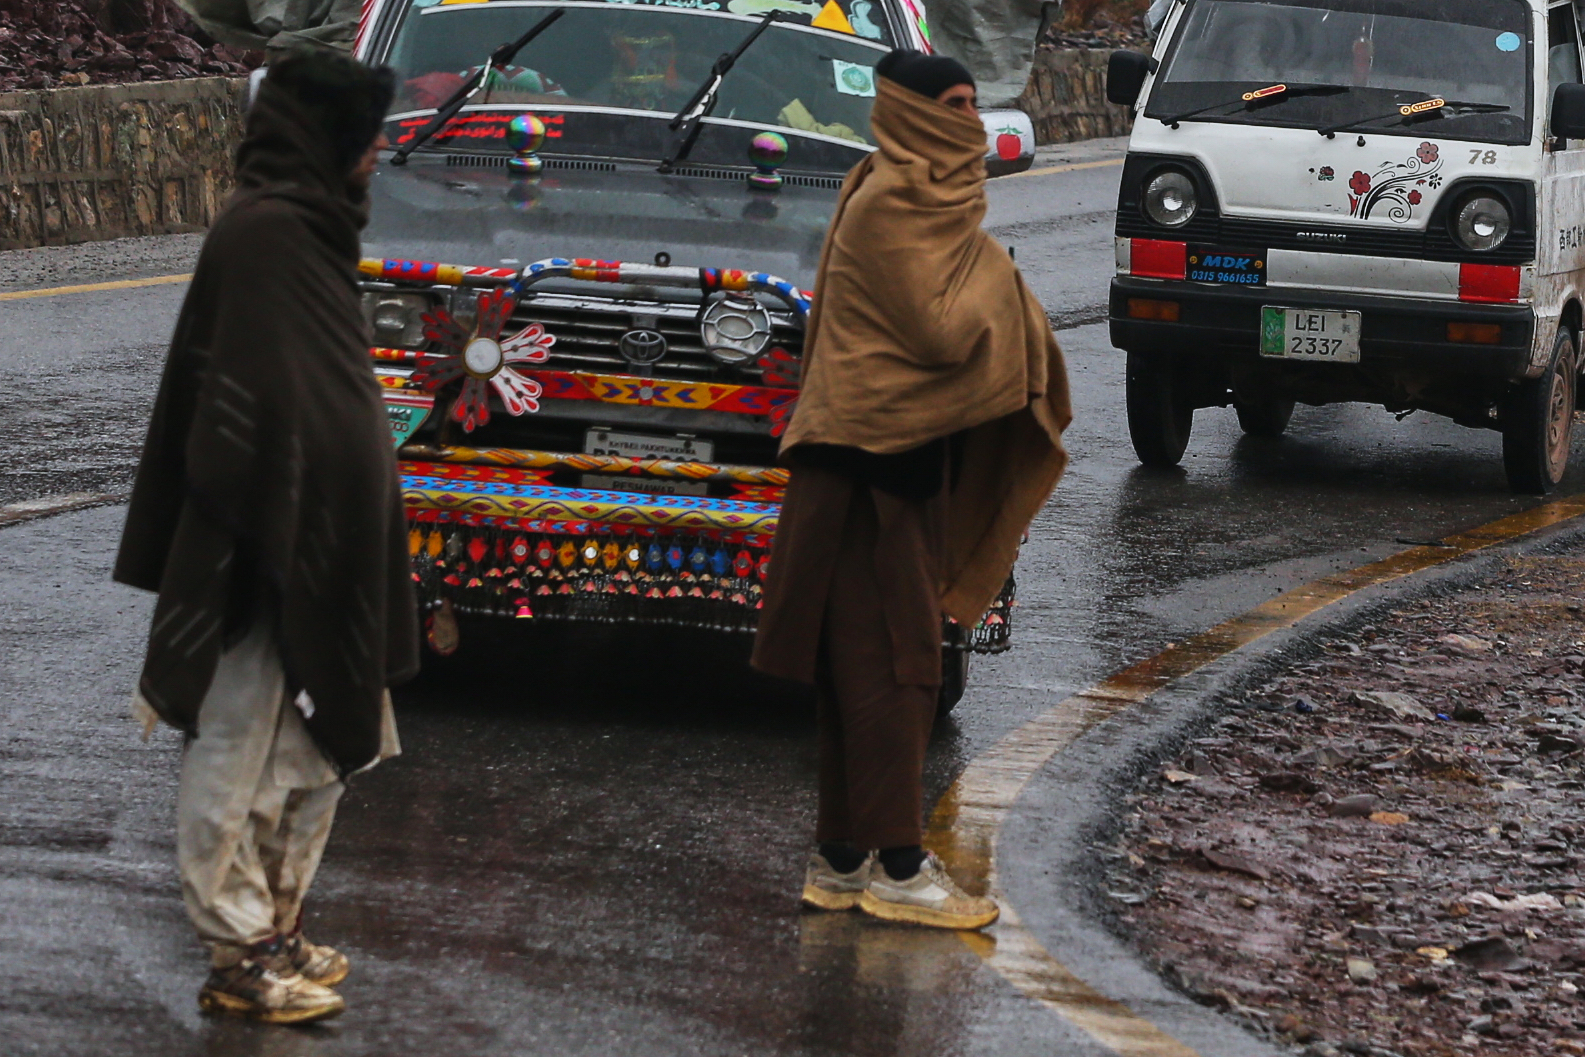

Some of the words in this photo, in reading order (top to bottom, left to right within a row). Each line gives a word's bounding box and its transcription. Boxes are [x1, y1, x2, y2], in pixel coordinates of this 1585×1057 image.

[1468, 149, 1497, 165] 78
[1296, 231, 1347, 243] SUZUKI
[1202, 255, 1251, 270] MDK
[1191, 270, 1215, 281] 0315
[1217, 271, 1259, 284] 9661655
[1295, 315, 1326, 332] LEI
[1291, 338, 1342, 356] 2337
